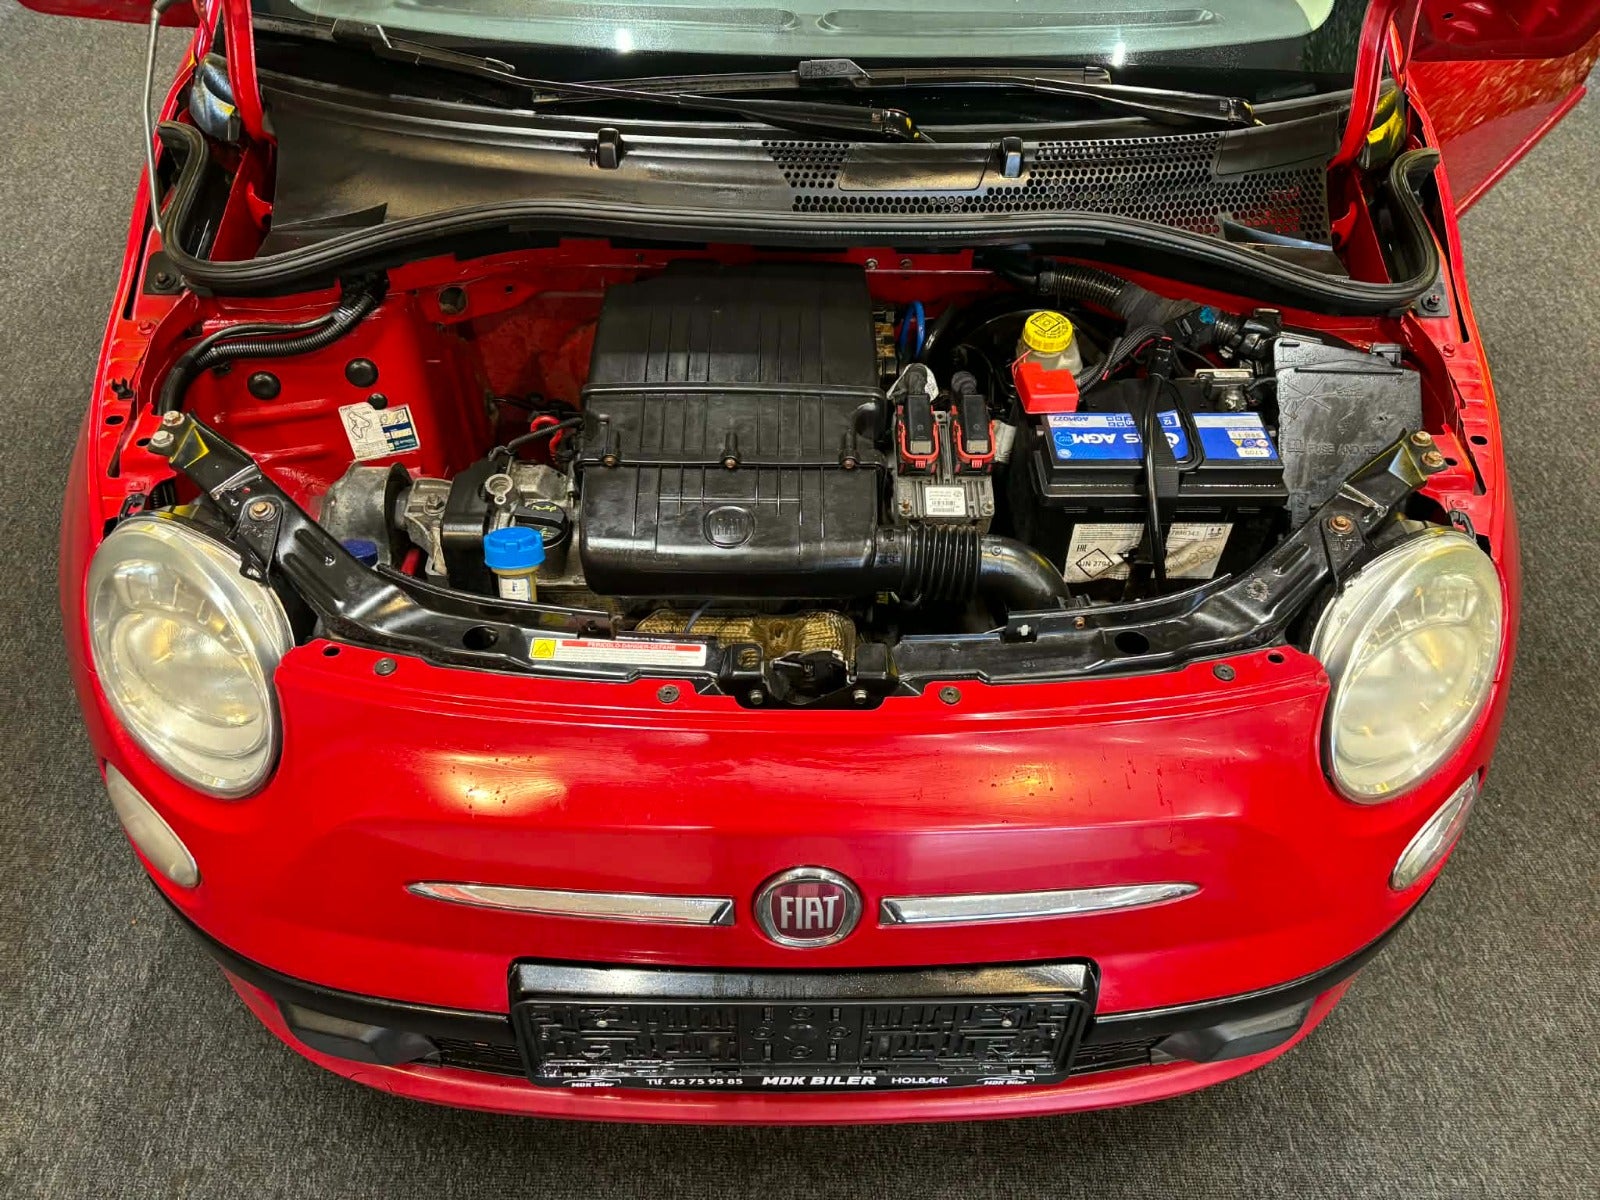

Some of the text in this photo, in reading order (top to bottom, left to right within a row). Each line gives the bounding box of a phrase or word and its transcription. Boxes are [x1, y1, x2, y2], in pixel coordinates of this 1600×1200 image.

[1073, 432, 1117, 446] AGM
[1307, 443, 1335, 454] FUSE
[1337, 443, 1359, 455] AND
[780, 895, 840, 930] FIAT
[762, 1076, 877, 1086] MDK BILER
[891, 1077, 949, 1085] HOLBÆK
